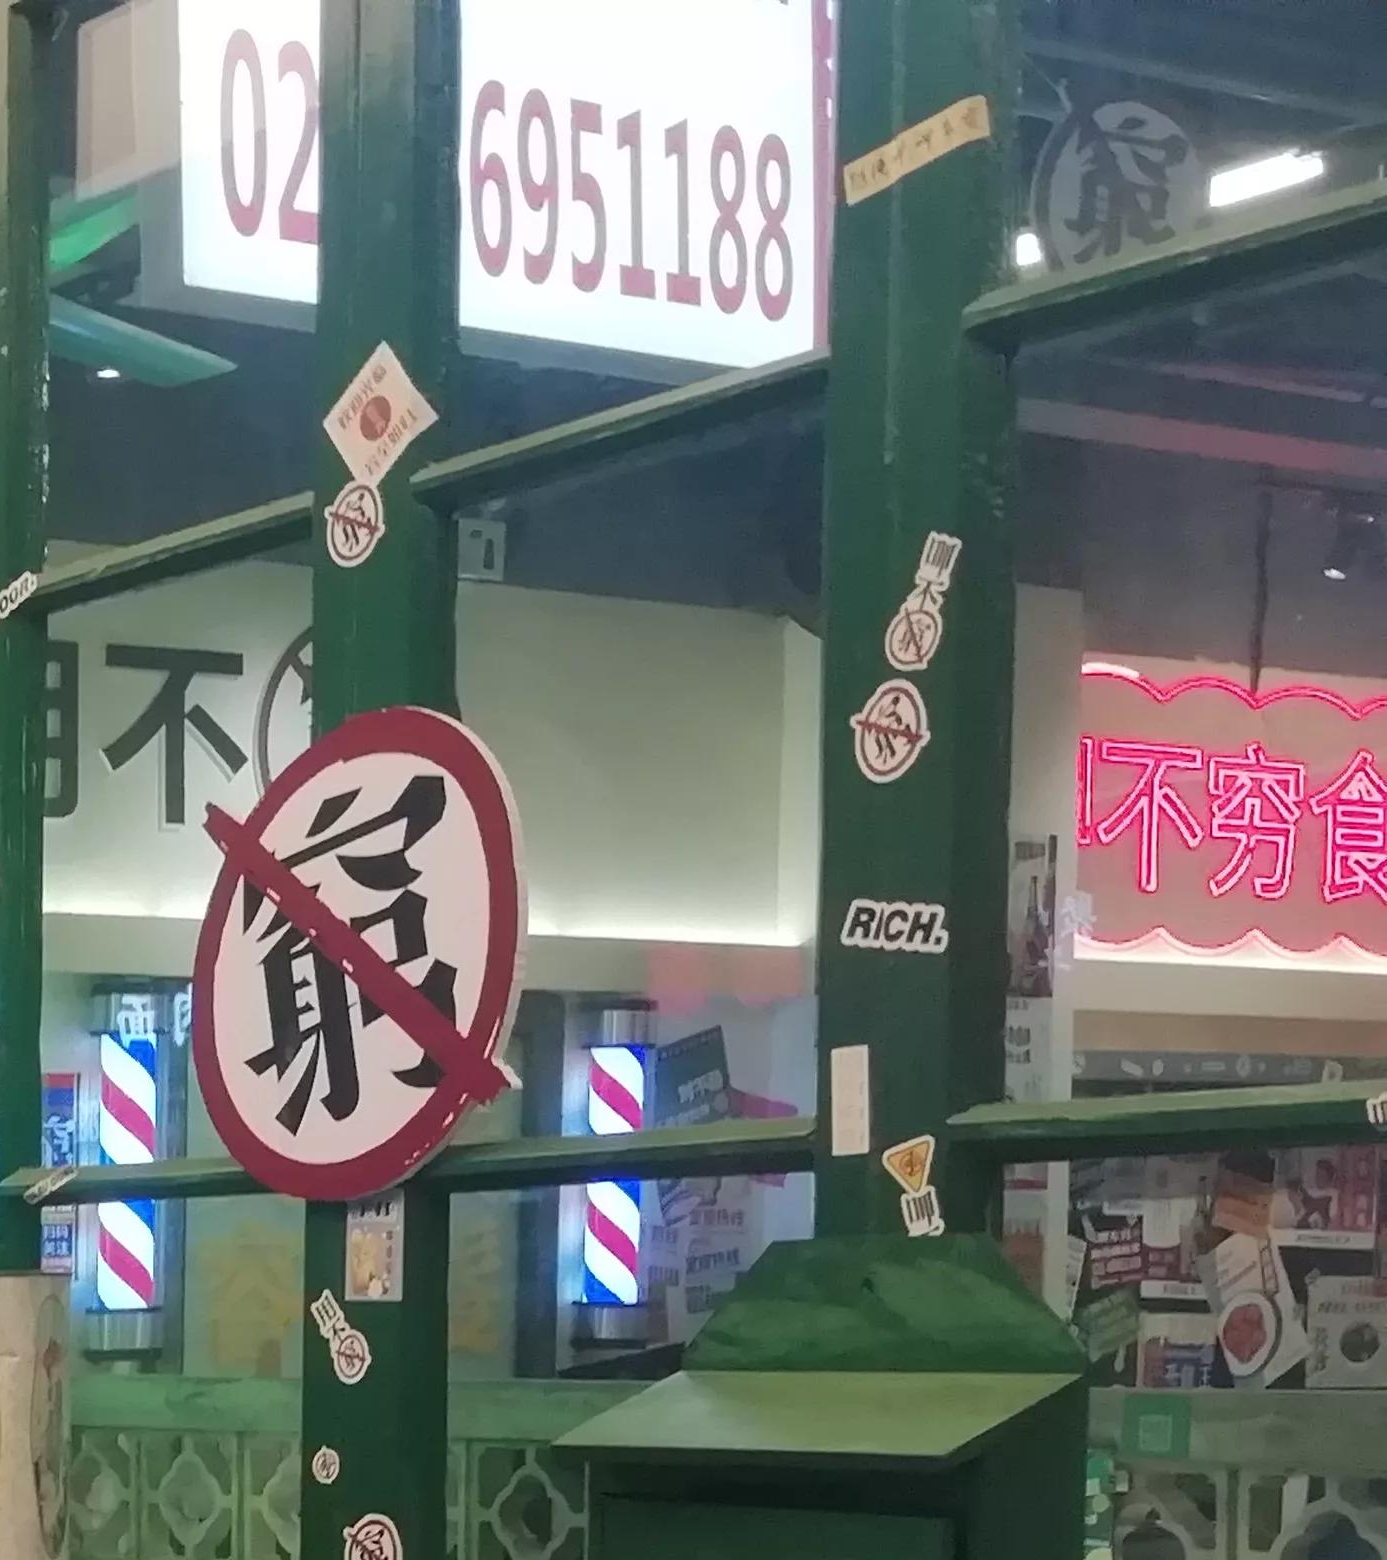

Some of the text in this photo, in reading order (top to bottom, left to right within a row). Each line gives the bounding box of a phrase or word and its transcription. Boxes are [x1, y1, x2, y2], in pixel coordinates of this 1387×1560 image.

[1077, 737, 1387, 902] 不穷食
[848, 906, 945, 947] RICH.
